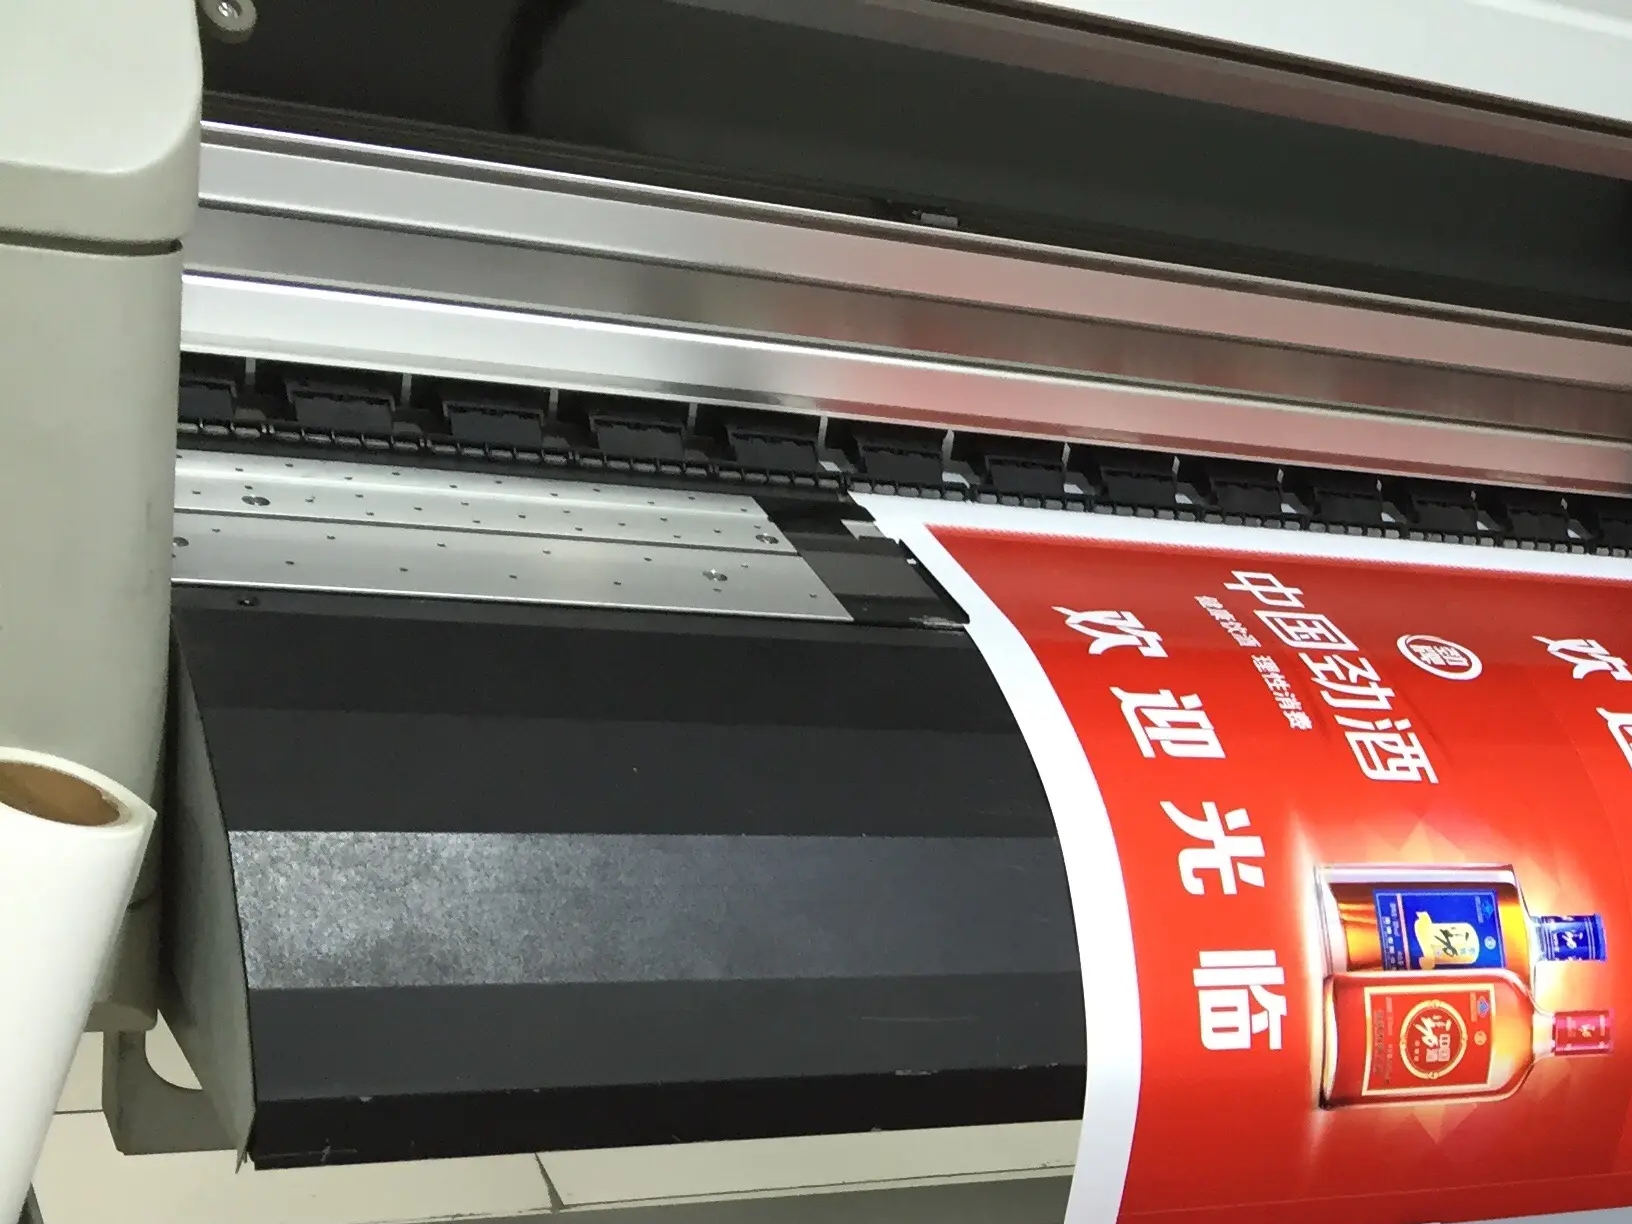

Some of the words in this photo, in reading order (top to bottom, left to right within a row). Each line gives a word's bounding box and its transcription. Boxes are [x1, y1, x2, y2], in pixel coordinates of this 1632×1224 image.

[1053, 607, 1287, 1050] 欢迎光临
[1224, 571, 1438, 783] 中国劲酒
